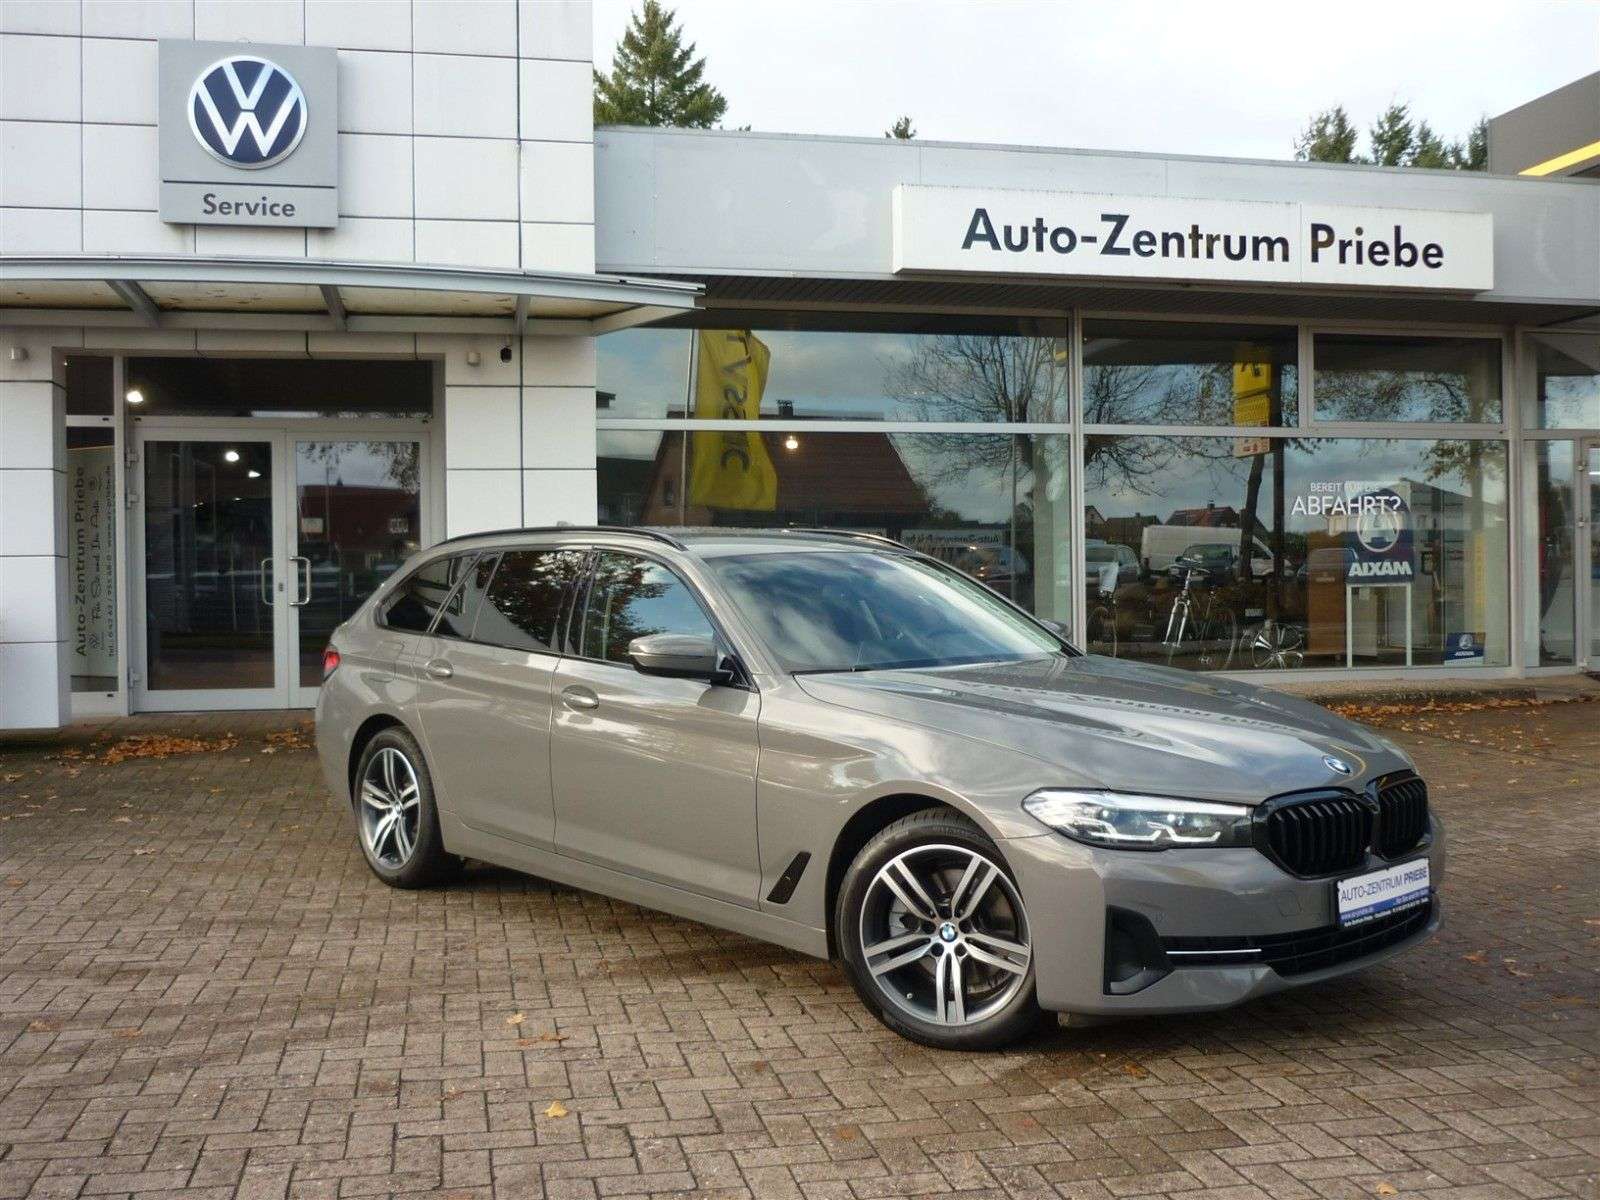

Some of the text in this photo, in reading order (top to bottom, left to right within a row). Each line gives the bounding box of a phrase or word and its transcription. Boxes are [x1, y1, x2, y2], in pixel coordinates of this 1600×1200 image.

[202, 192, 296, 217] Service
[961, 207, 1445, 269] Auto-Zentrum Priebe
[1310, 482, 1342, 492] BEREIT
[1291, 495, 1401, 516] ABFAHRT?
[75, 466, 87, 657] Auto-Zentrum Priebe
[1348, 560, 1412, 577] AIXAM
[1341, 874, 1402, 902] AUTO-ZENTRUM
